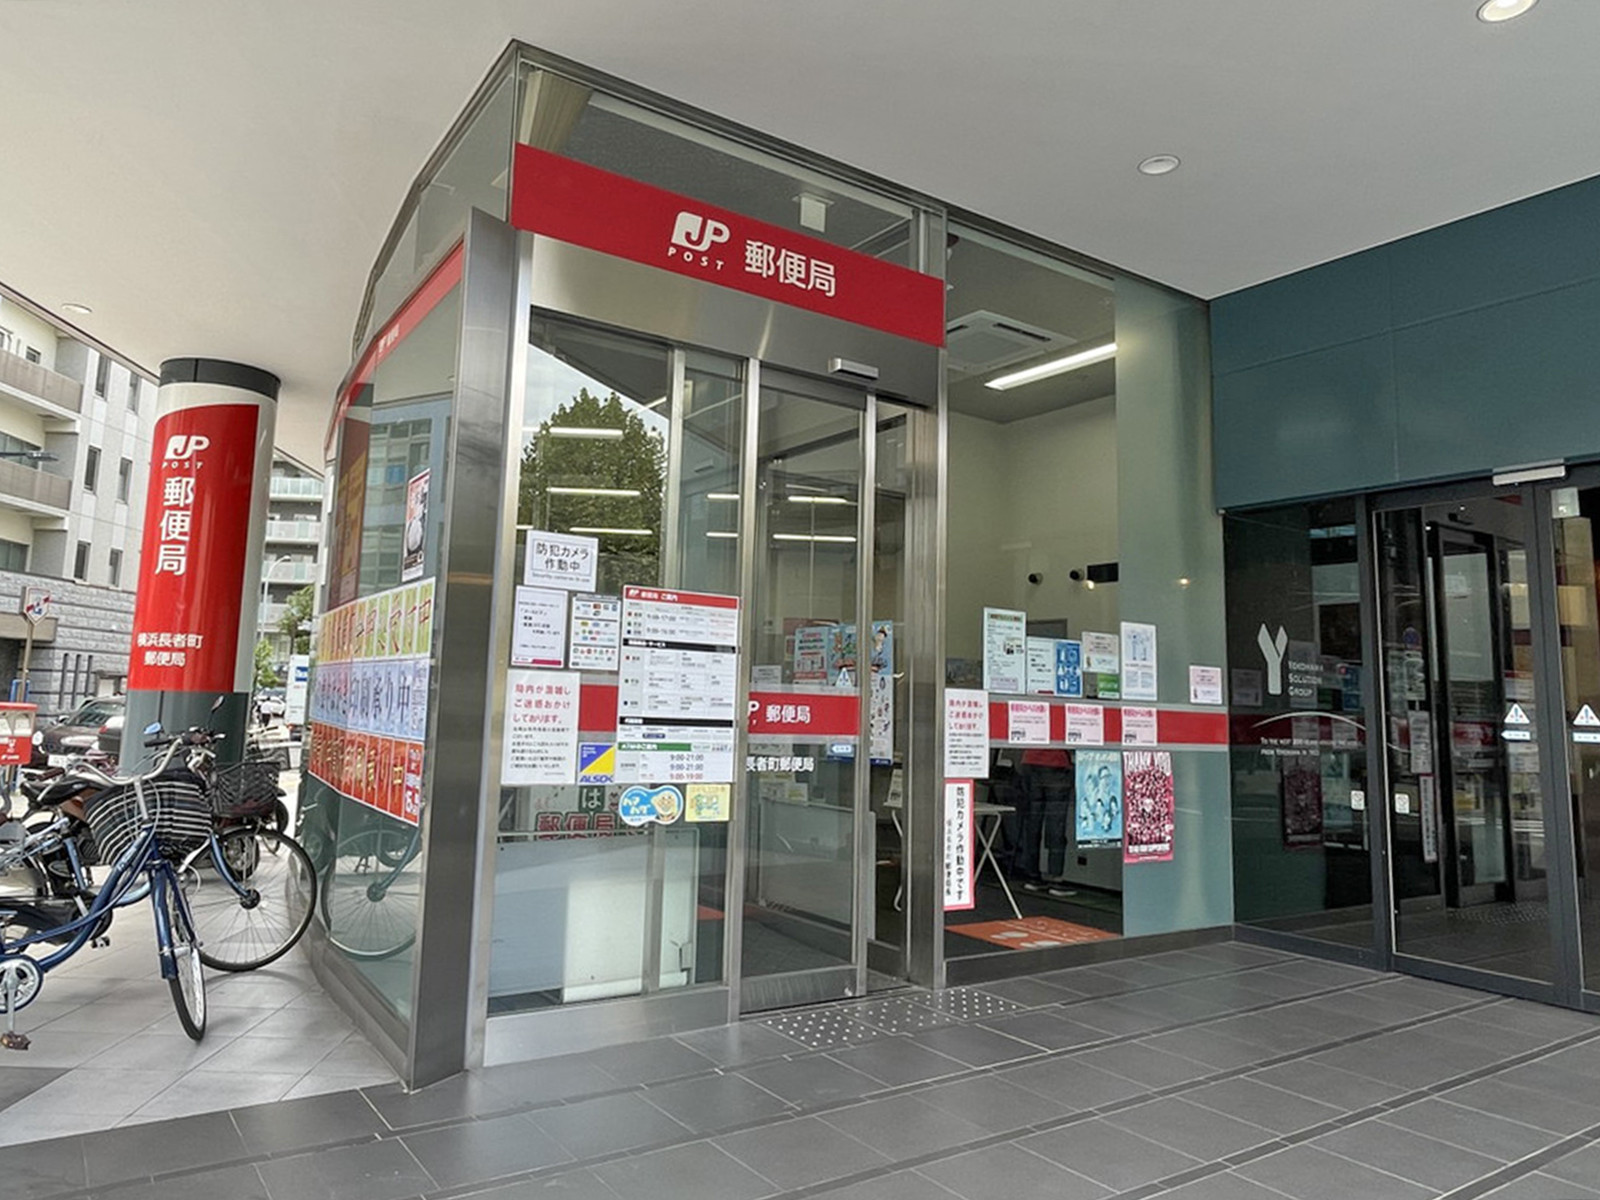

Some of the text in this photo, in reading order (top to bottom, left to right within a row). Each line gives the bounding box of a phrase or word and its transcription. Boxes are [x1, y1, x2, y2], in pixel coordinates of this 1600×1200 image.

[671, 211, 730, 252] JP
[667, 246, 724, 270] POST
[745, 239, 836, 297] 郵便局
[164, 435, 210, 460] JP
[162, 461, 203, 469] POST
[155, 476, 195, 576] 郵便局
[536, 542, 589, 560] 防犯カメラ
[545, 558, 580, 571] 作動中
[137, 632, 203, 649] 横浜長者町
[144, 651, 186, 667] 郵便局
[515, 684, 571, 695] 局内が混雑し
[514, 699, 570, 710] ご迷惑おかけ
[765, 704, 811, 723] 郵便局
[580, 775, 614, 783] ALSOK
